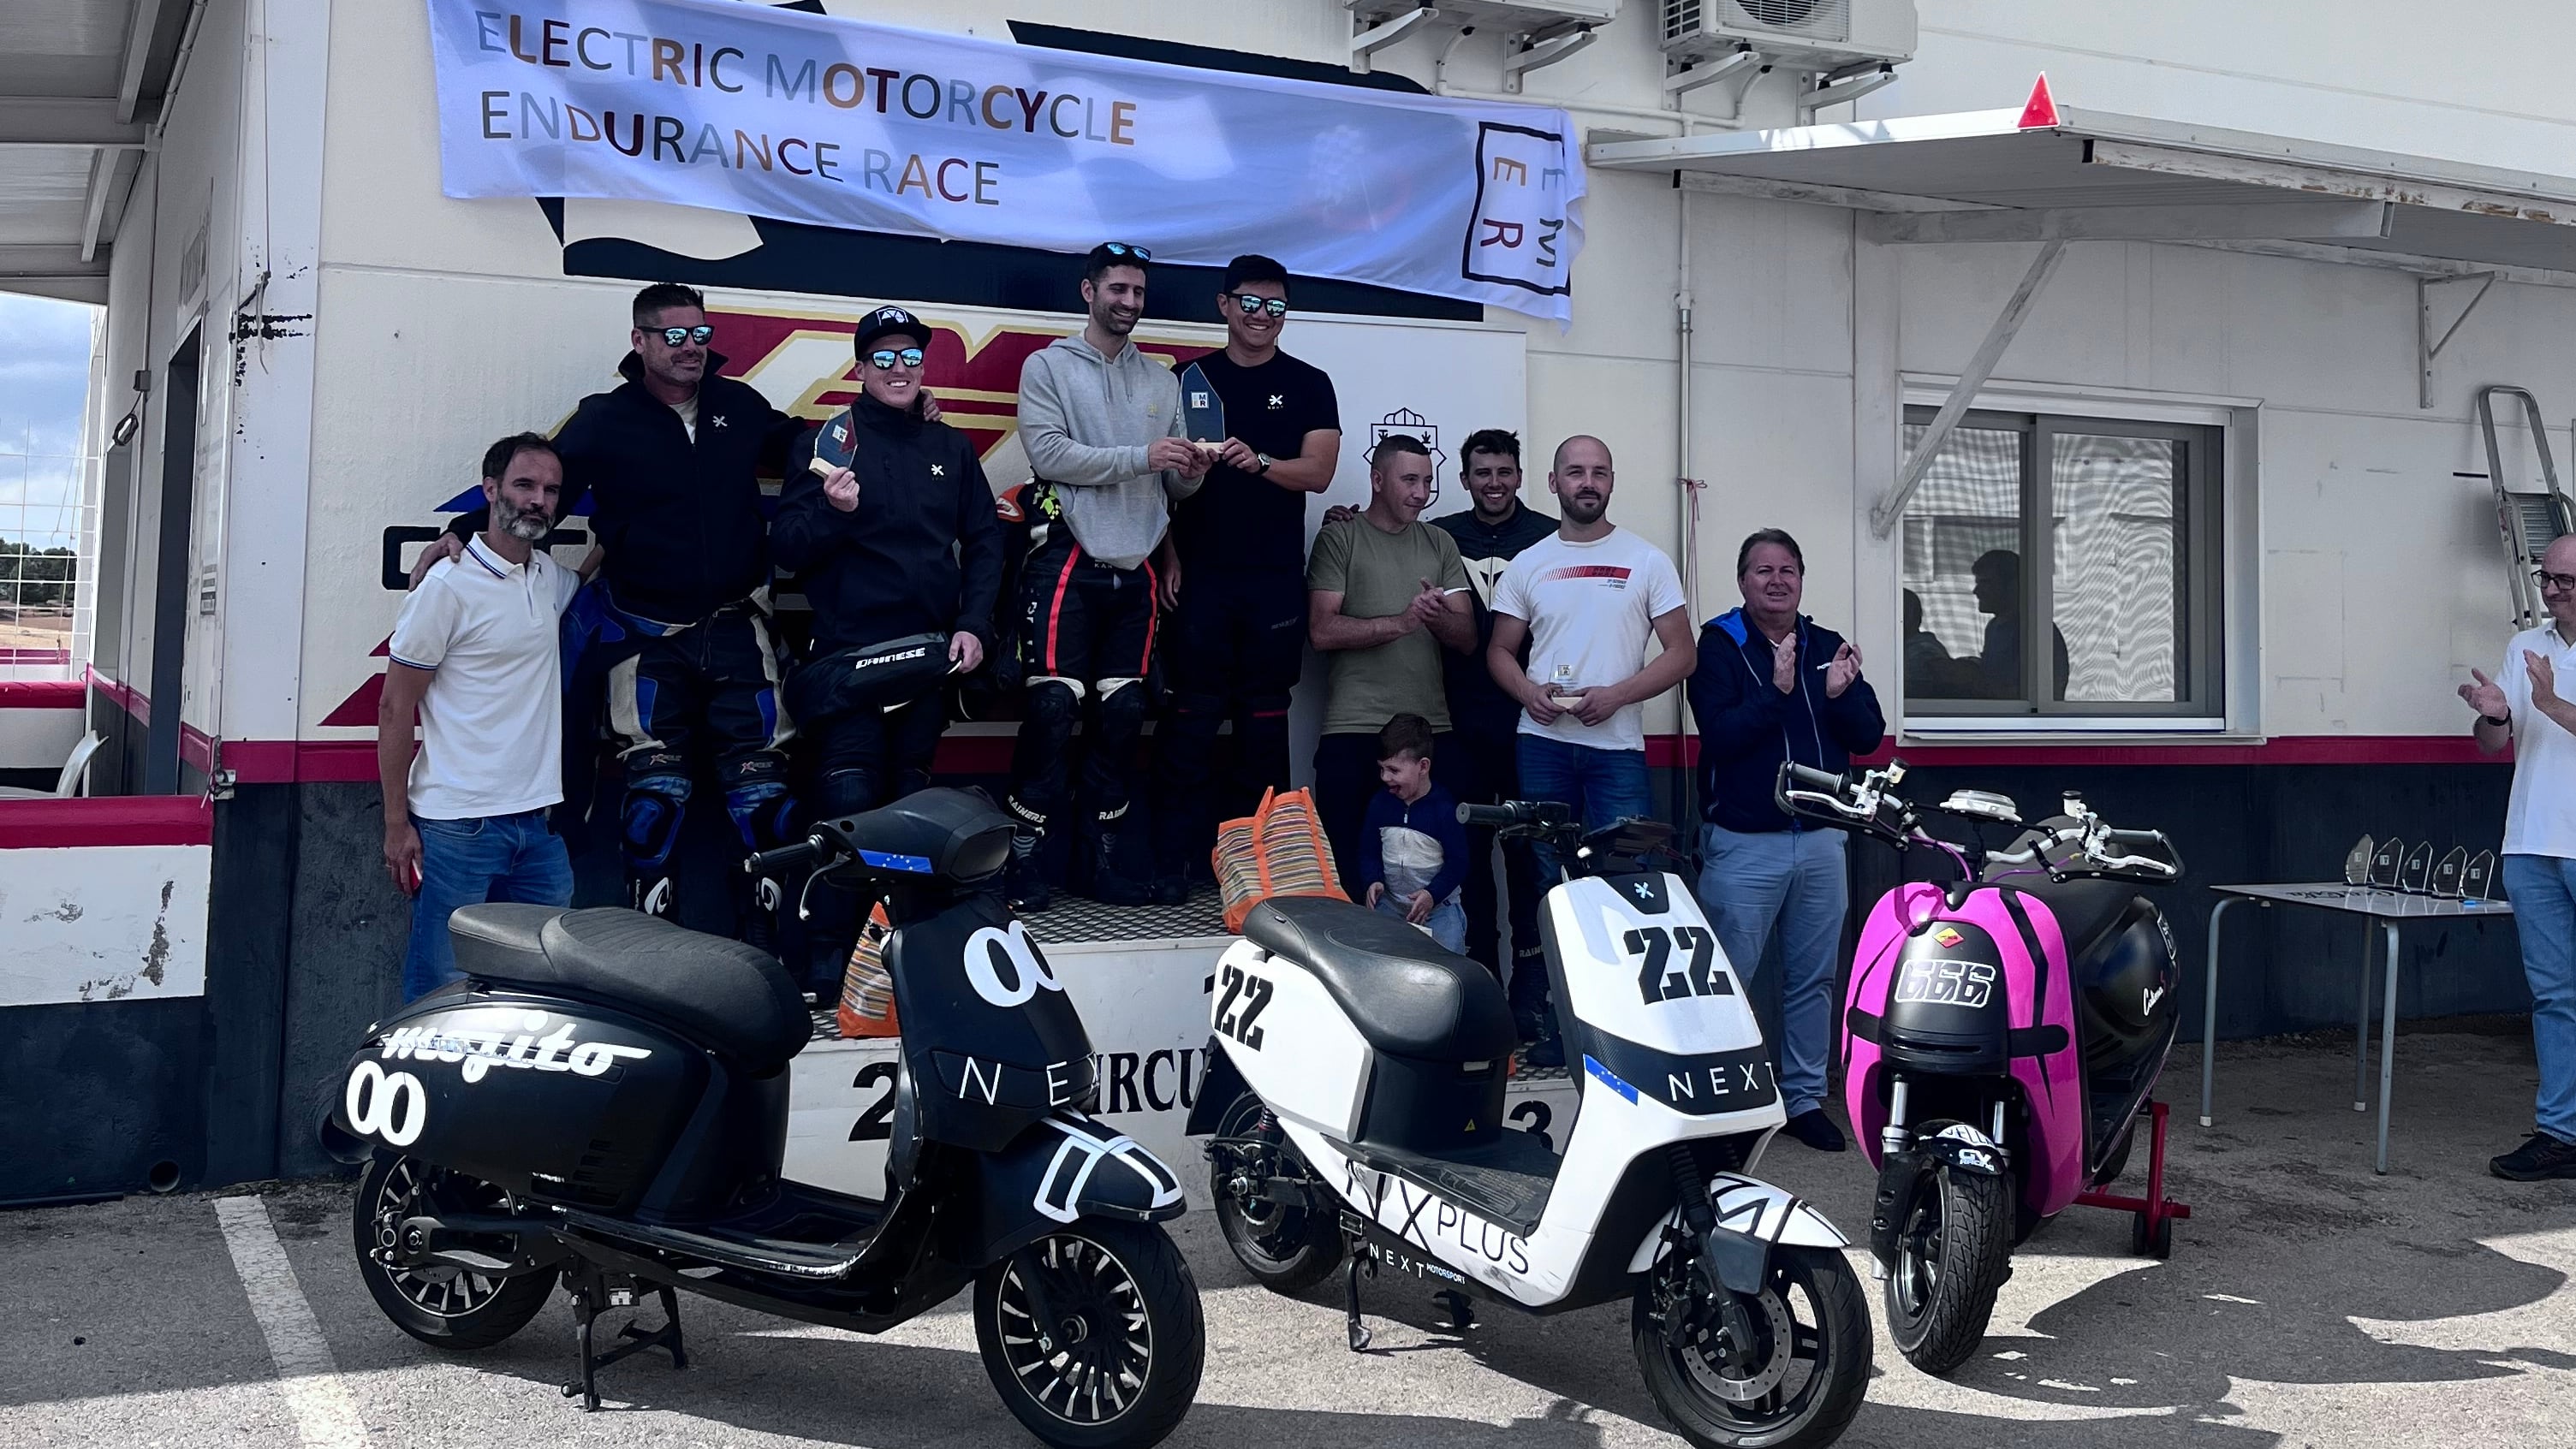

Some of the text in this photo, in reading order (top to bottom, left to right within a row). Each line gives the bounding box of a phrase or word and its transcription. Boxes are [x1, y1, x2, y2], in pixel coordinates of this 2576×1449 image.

[477, 10, 1138, 146] ELECTRIC MOTORCYCLE
[481, 90, 1000, 206] ENDURANCE RACE
[856, 647, 925, 670] DAINESE
[964, 920, 1065, 1007] 00
[1623, 926, 1735, 1006] 22
[1895, 959, 1996, 1008] 666
[379, 1010, 653, 1084] mojito
[1213, 964, 1275, 1053] 22
[346, 1060, 426, 1147] 00
[848, 1062, 897, 1143] 2
[1370, 1242, 1466, 1285] NEXT MOTORSPORT
